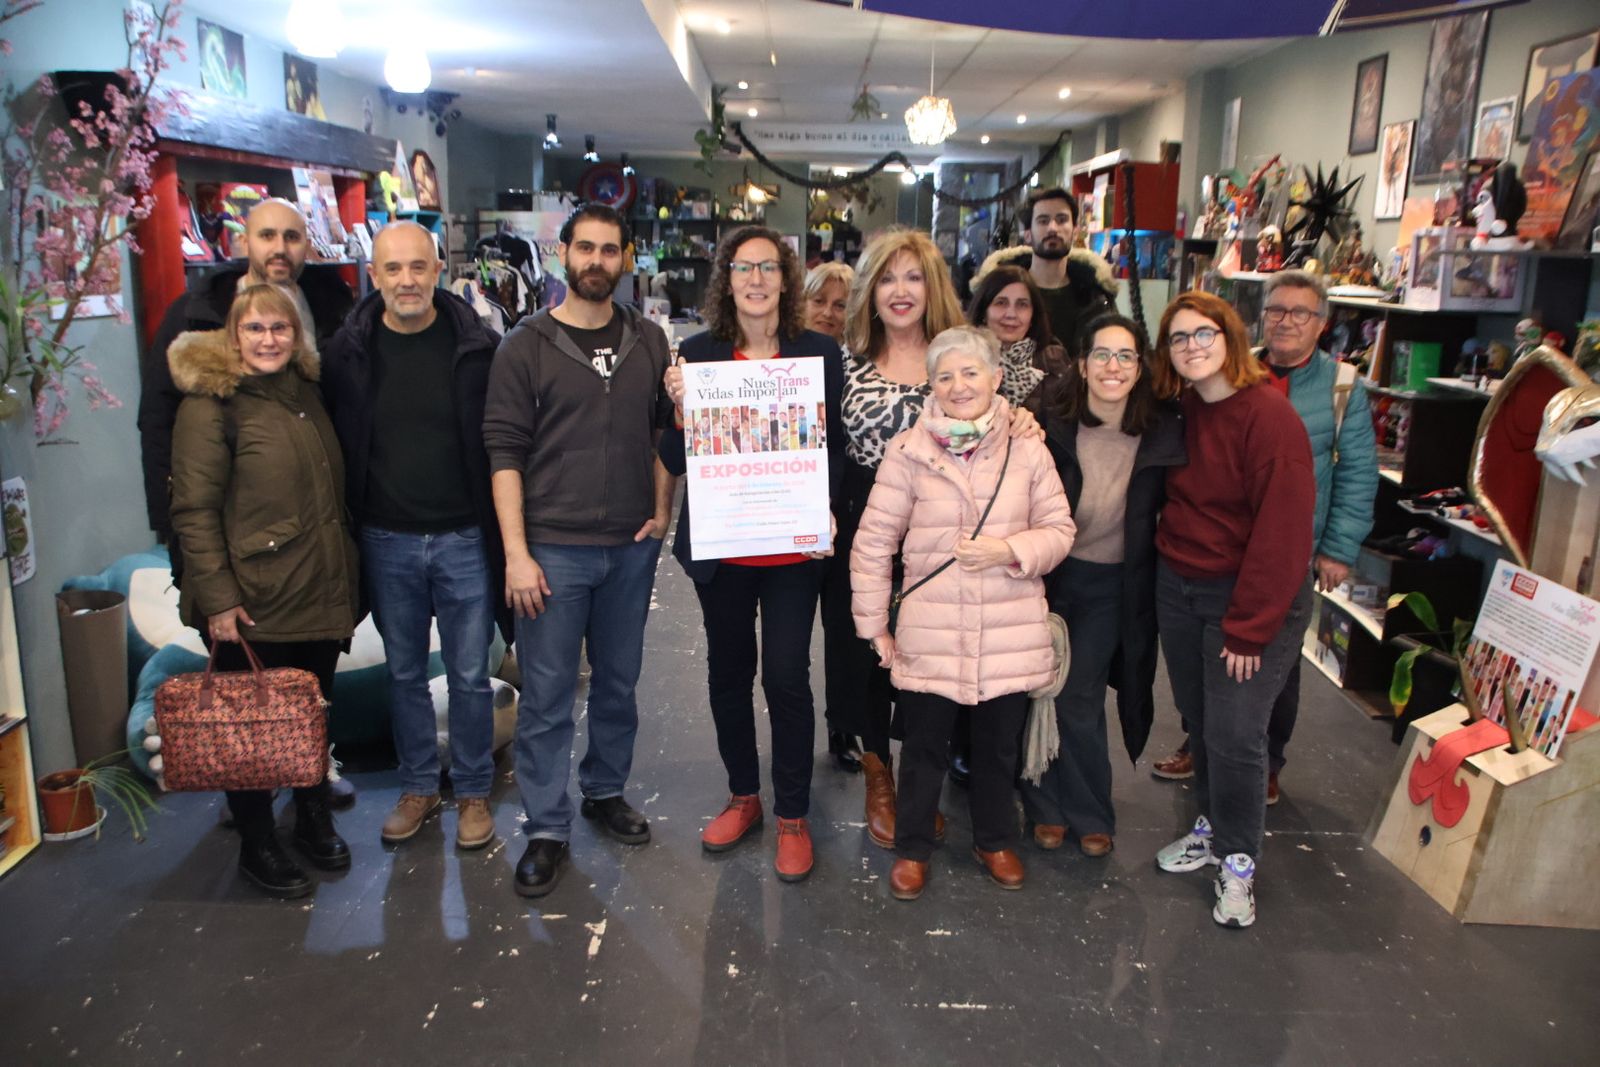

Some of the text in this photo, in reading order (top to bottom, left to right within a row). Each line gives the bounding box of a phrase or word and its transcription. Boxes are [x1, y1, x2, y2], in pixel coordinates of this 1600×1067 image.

[594, 347, 613, 355] THE
[697, 387, 734, 400] Vidas
[700, 457, 817, 479] EXPOSICIÓN
